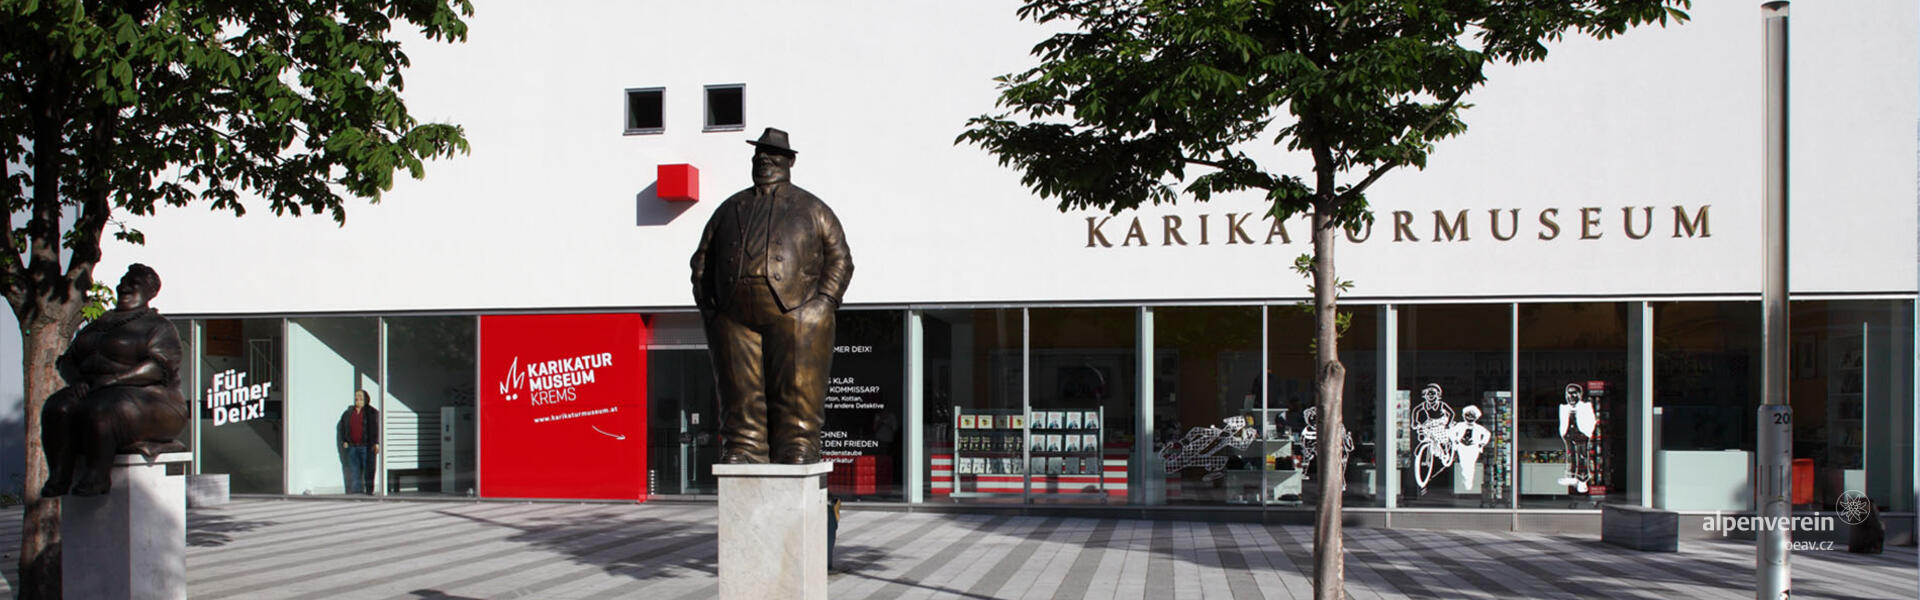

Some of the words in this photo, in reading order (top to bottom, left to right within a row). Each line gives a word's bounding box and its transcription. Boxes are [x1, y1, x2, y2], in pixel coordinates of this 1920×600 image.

[1085, 204, 1712, 248] KARIKATURMUSEUM
[851, 345, 873, 353] DEIX!
[527, 352, 613, 378] KARIKATUR
[213, 369, 246, 392] Für
[529, 369, 596, 392] MUSEUM
[830, 385, 880, 393] KOMMISSAR?
[207, 381, 272, 409] immer
[531, 386, 577, 406] KREMS
[213, 399, 265, 427] Deix!
[534, 406, 618, 423] www.karikaturmuseum.at
[1774, 412, 1790, 425] 20
